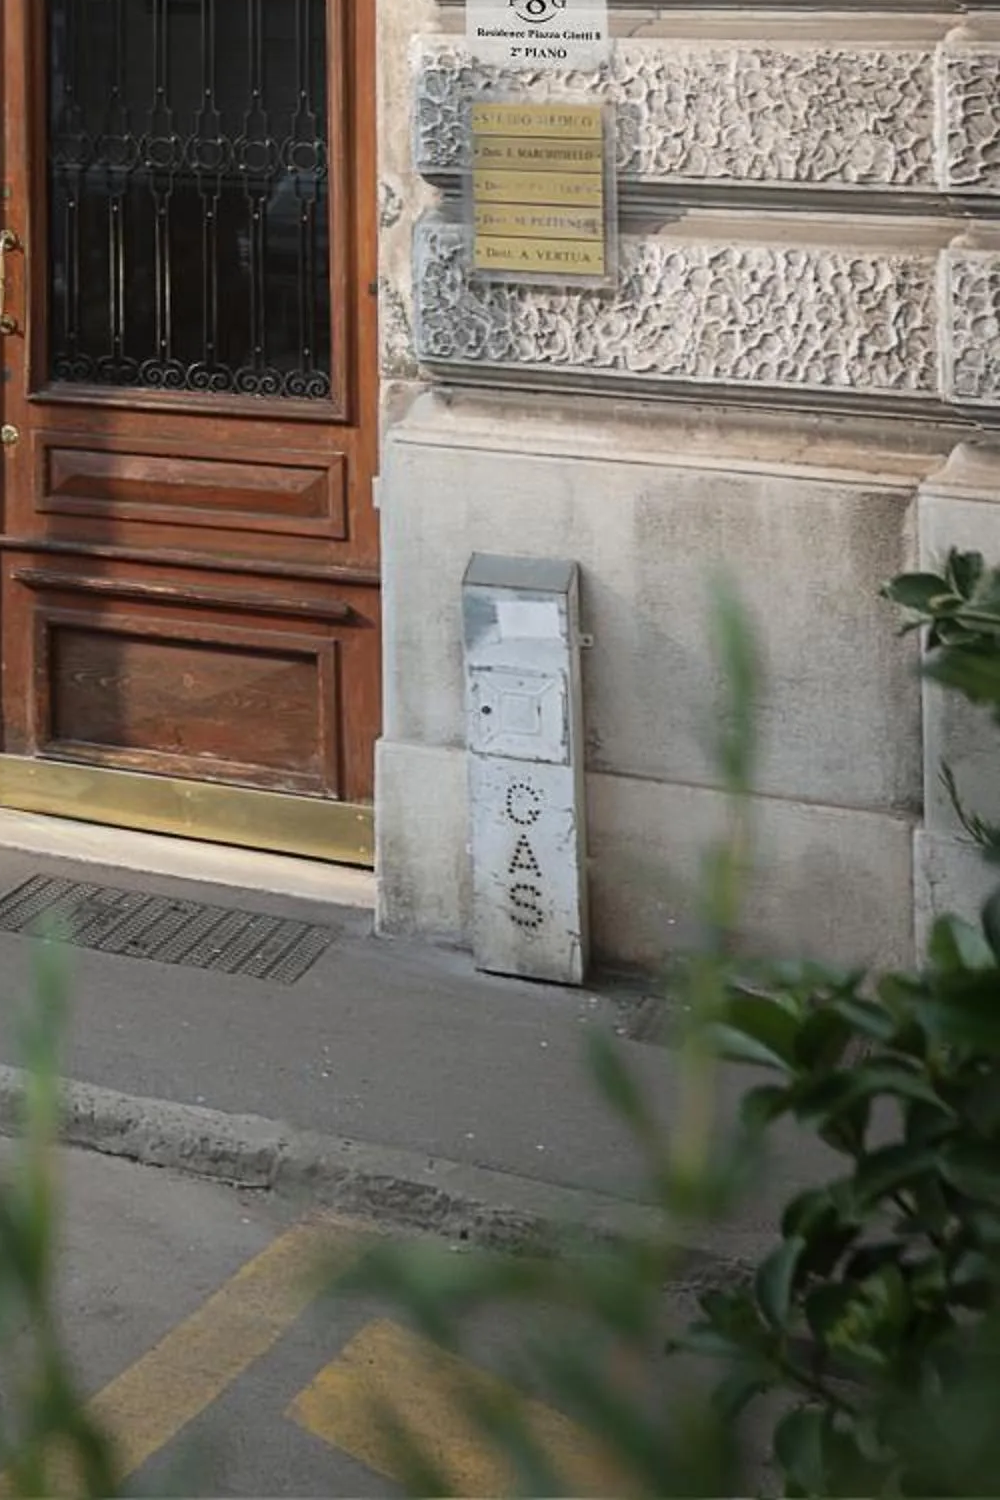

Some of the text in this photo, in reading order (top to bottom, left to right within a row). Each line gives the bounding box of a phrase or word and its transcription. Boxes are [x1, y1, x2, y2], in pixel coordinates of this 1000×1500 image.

[477, 27, 525, 39] Residence
[528, 29, 560, 40] Piazza
[525, 47, 567, 59] PIANO
[506, 782, 544, 928] GAS
